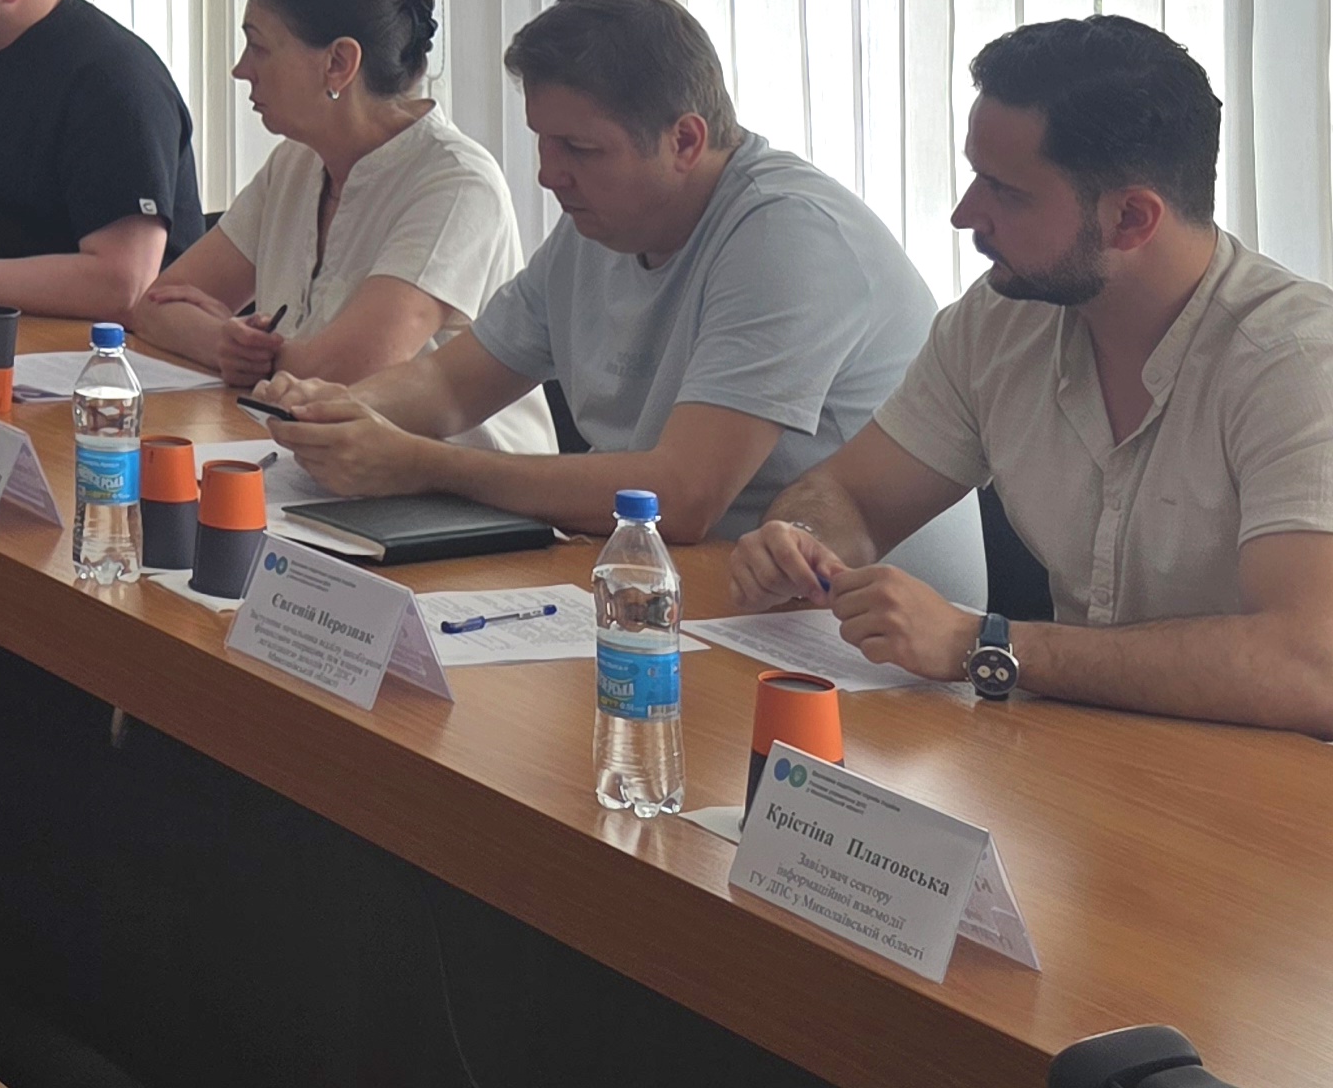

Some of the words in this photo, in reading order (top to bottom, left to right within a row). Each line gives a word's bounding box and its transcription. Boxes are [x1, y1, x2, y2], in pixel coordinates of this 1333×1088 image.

[272, 593, 316, 622] Євгеній
[766, 803, 834, 846] Крістіна
[847, 838, 949, 896] Платовська
[777, 862, 853, 907] інформаційної
[797, 852, 849, 884] Завідувач
[850, 879, 892, 906] сектору
[749, 870, 767, 886] ГУ
[766, 879, 793, 899] ДПС
[792, 894, 802, 907] у
[802, 895, 880, 940] Миколаївській
[881, 934, 925, 960] області
